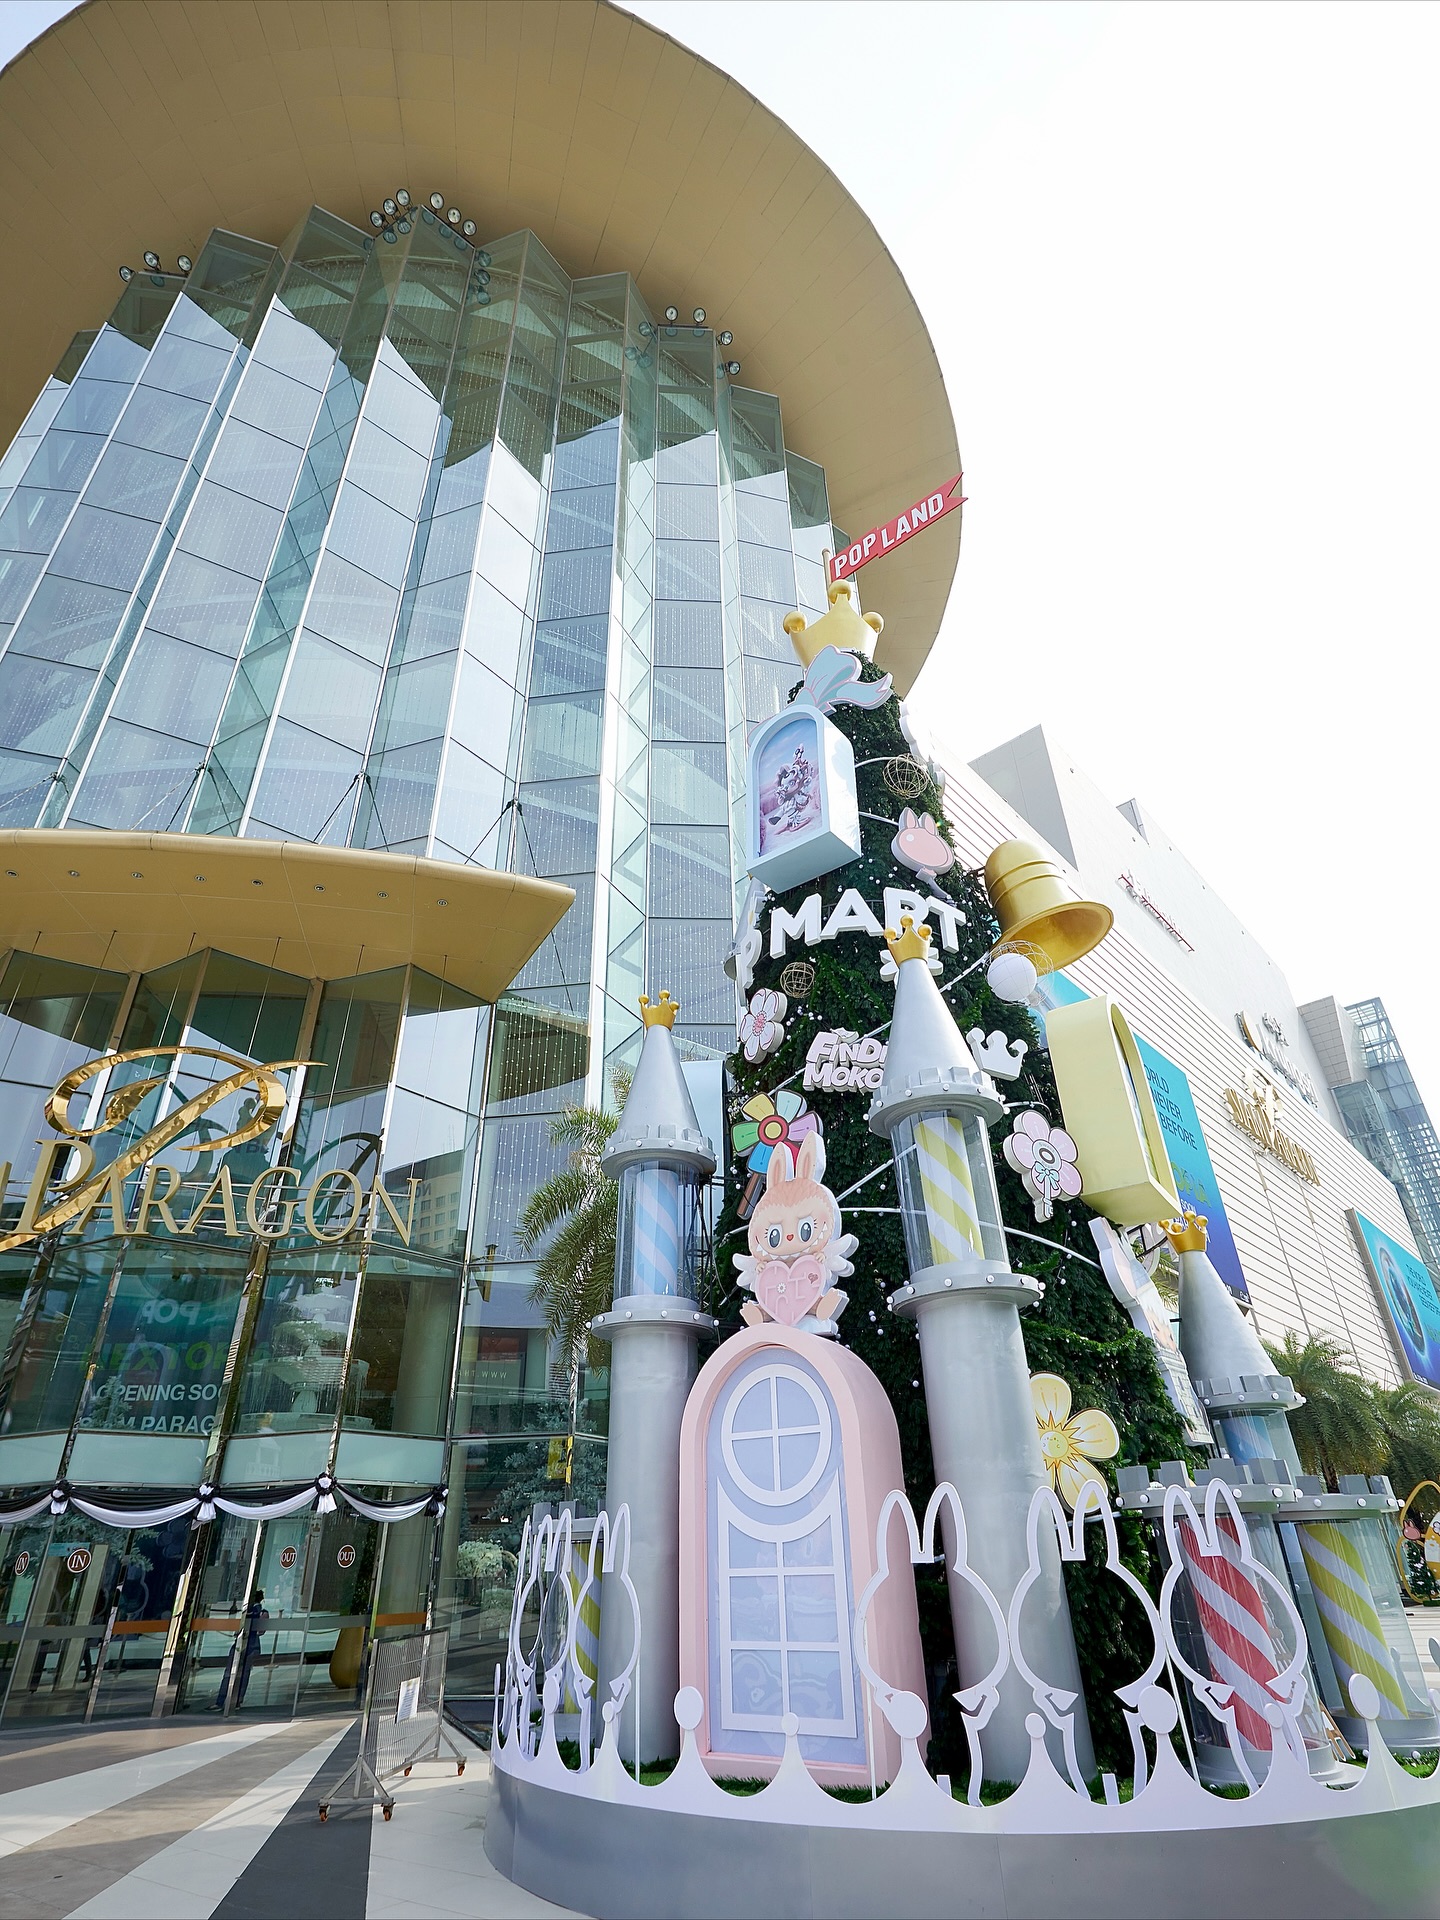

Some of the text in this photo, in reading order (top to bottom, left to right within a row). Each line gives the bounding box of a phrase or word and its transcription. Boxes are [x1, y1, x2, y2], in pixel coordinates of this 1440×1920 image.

[834, 493, 944, 577] POP LAND
[769, 887, 966, 959] MART
[805, 1031, 888, 1067] FINDI
[802, 1062, 885, 1092] MOKO
[1159, 1111, 1198, 1151] BEFORE
[7, 1139, 422, 1247] PARAGON
[140, 1415, 214, 1435] PARAG
[16, 1556, 28, 1570] IN
[71, 1554, 87, 1568] IN
[281, 1552, 296, 1563] OUT
[339, 1551, 354, 1562] OUT
